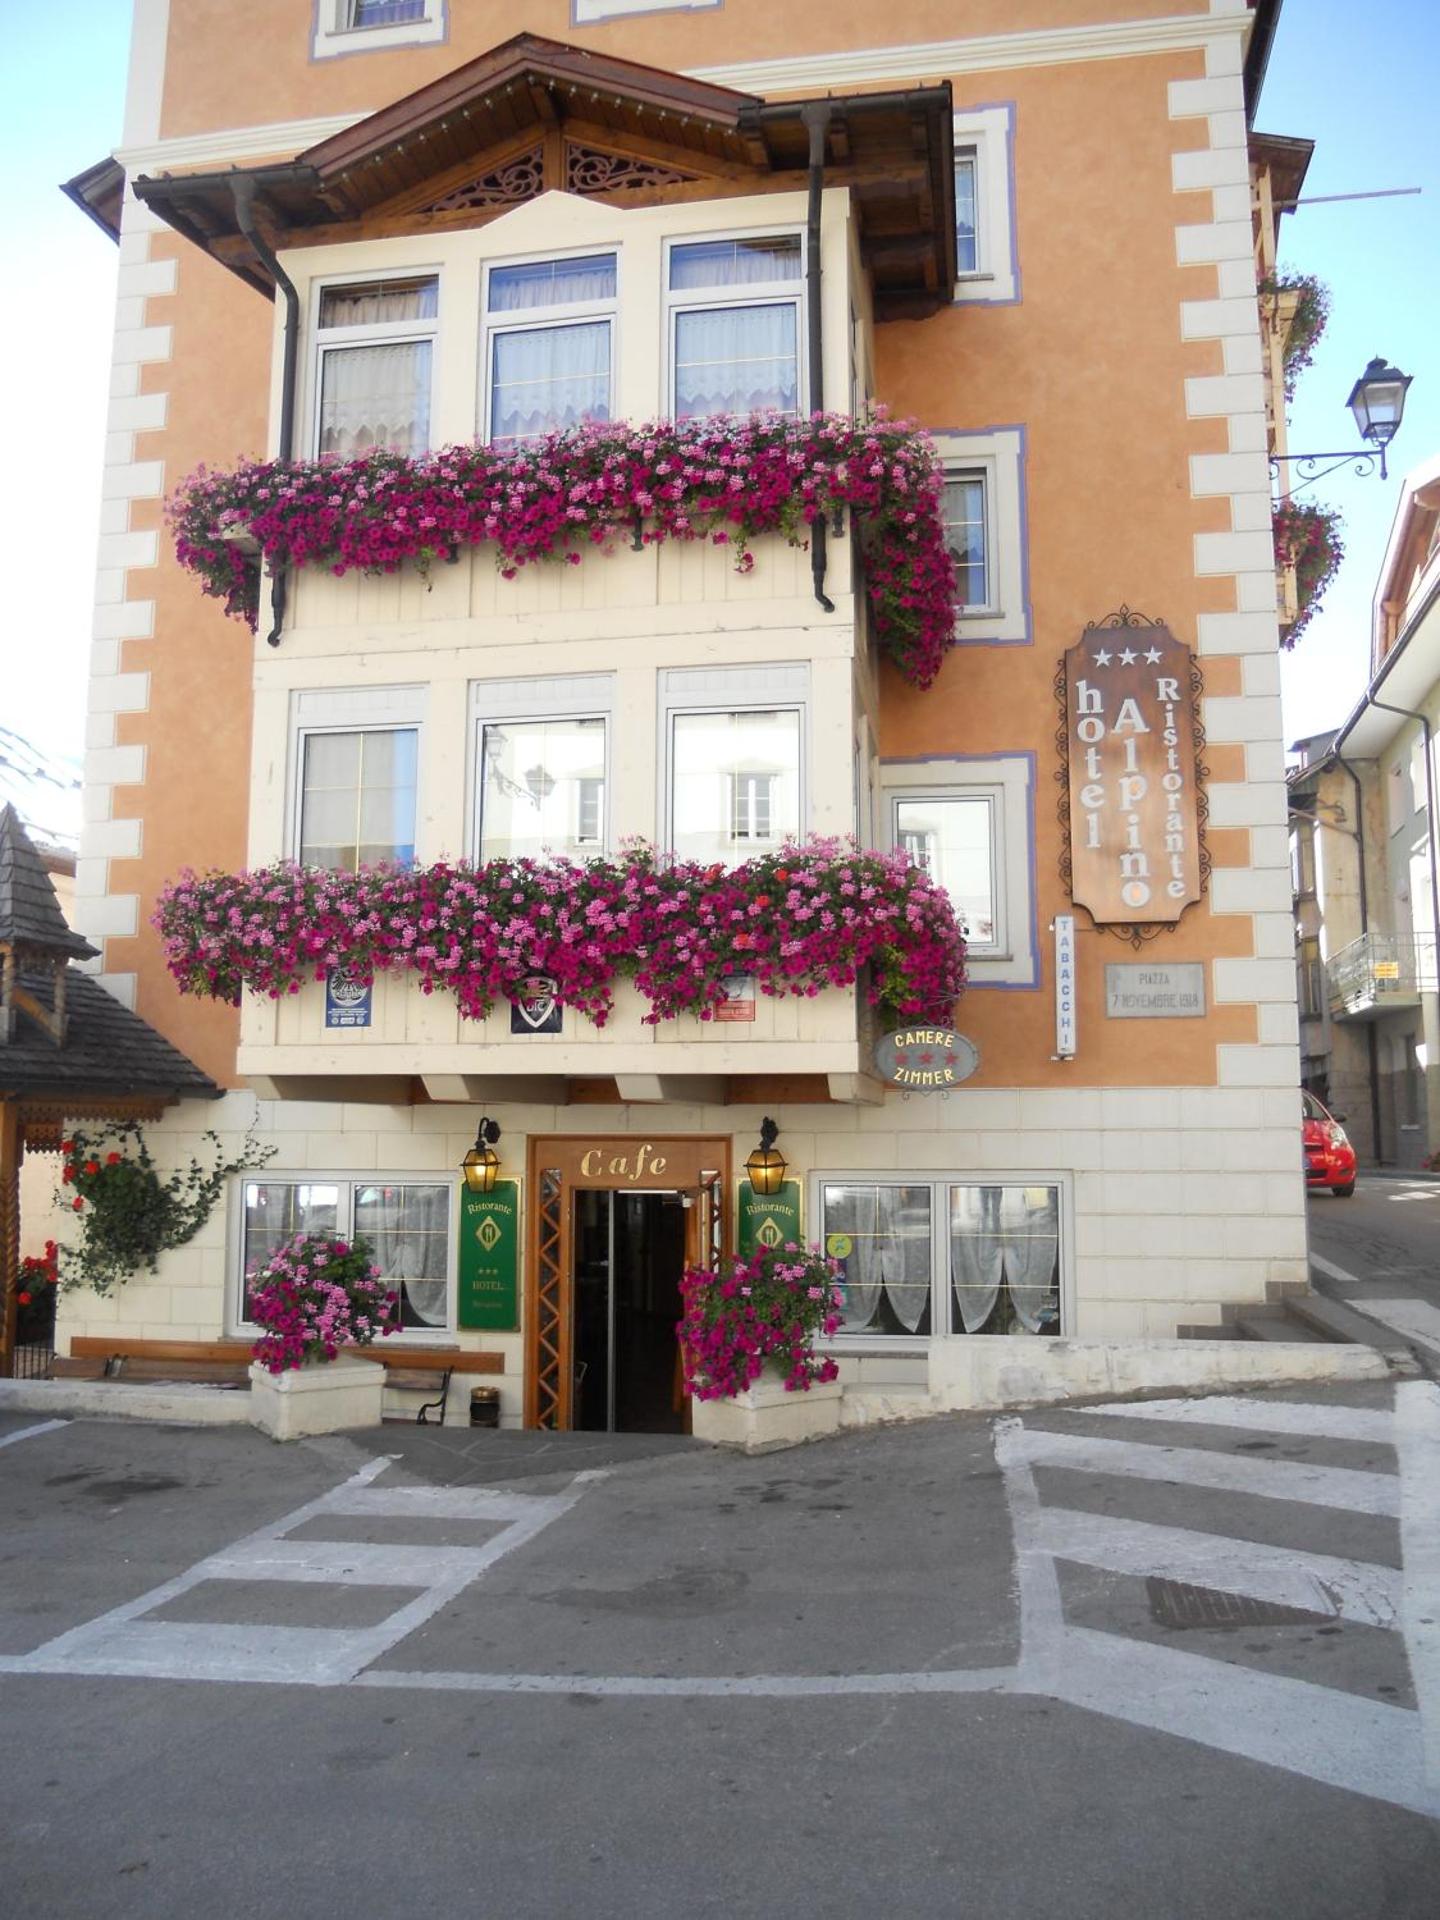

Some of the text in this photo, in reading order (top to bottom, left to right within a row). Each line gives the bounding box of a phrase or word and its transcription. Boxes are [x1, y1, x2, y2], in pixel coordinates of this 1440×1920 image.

[1076, 680, 1105, 848] hotel
[1156, 678, 1186, 898] Ristorante
[1111, 698, 1150, 907] Alpino
[1060, 920, 1071, 1045] TABACCHI
[1139, 973, 1170, 985] PIAZZA
[1122, 993, 1177, 1008] NOVEMBRE
[895, 1030, 955, 1048] CAMERE
[894, 1067, 955, 1086] ZIMMER
[581, 1144, 667, 1181] Cafe
[467, 1202, 512, 1215] Ristorante
[746, 1202, 795, 1217] Ristorante
[472, 1280, 504, 1290] HOTEL
